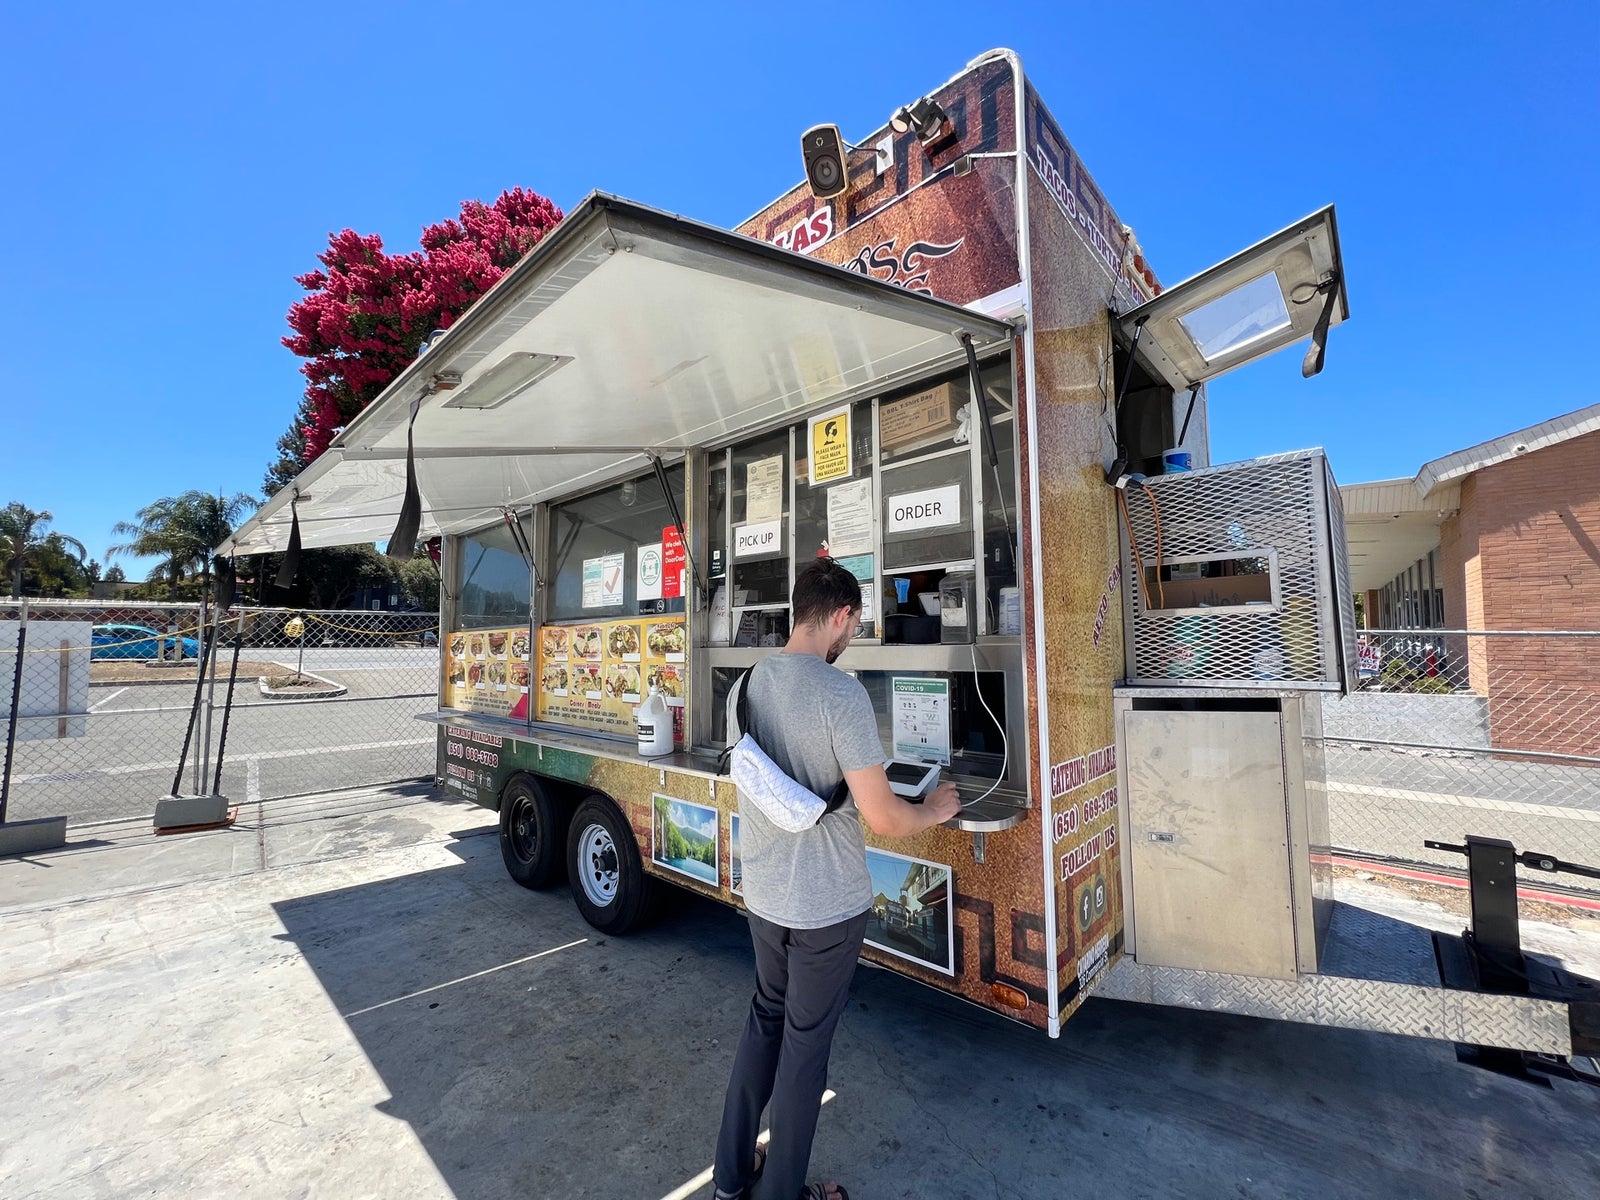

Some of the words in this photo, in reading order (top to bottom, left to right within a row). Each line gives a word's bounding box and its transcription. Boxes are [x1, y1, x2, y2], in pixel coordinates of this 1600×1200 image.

[1037, 145, 1076, 218] TACOS
[1088, 216, 1123, 283] TORTAS
[894, 502, 942, 521] ORDER
[739, 535, 759, 548] PICK
[761, 532, 774, 545] UP
[447, 740, 463, 758] (650)
[466, 746, 499, 768] 669-3798
[472, 730, 502, 748] AVAILABLE
[1051, 756, 1085, 799] CATERING
[1088, 744, 1116, 783] AVAILABLE
[1052, 803, 1079, 844] (650)
[1083, 786, 1118, 824] 669-3798
[1061, 832, 1101, 881] FOLLOW
[1104, 823, 1115, 850] US
